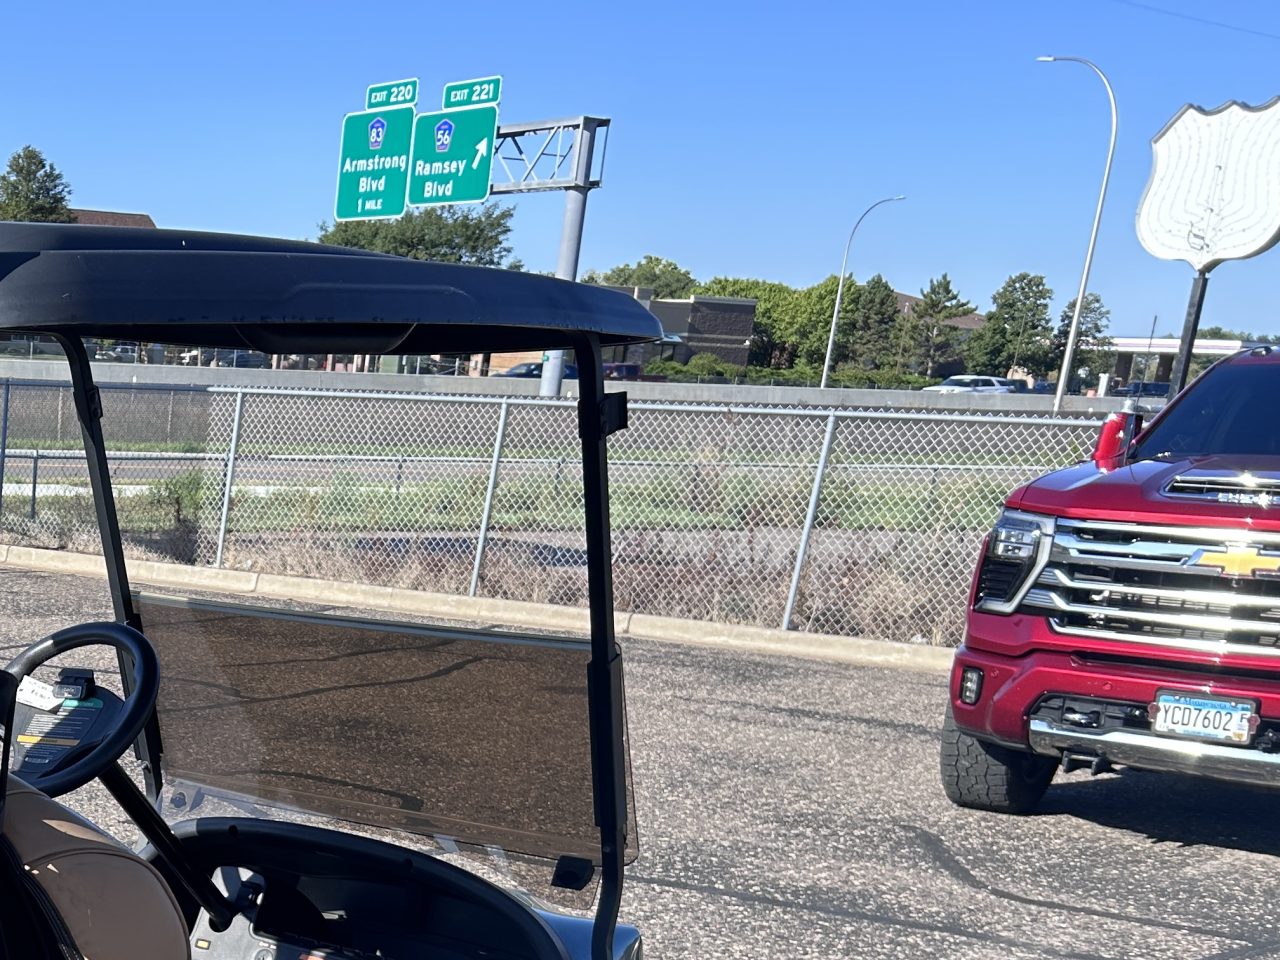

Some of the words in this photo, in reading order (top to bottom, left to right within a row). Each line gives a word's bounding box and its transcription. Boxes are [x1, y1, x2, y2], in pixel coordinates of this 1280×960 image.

[371, 91, 387, 103] EXIT
[390, 85, 413, 102] 220
[451, 89, 468, 102] EXIT
[471, 83, 494, 100] 221
[370, 128, 383, 142] 83
[437, 130, 450, 145] 56
[343, 155, 407, 173] Armstrong
[415, 159, 466, 176] Ramsey
[359, 176, 385, 192] Blvd
[424, 180, 453, 198] Blvd
[357, 198, 362, 212] 1
[365, 199, 383, 210] MILE
[1163, 704, 1233, 732] YCD7602
